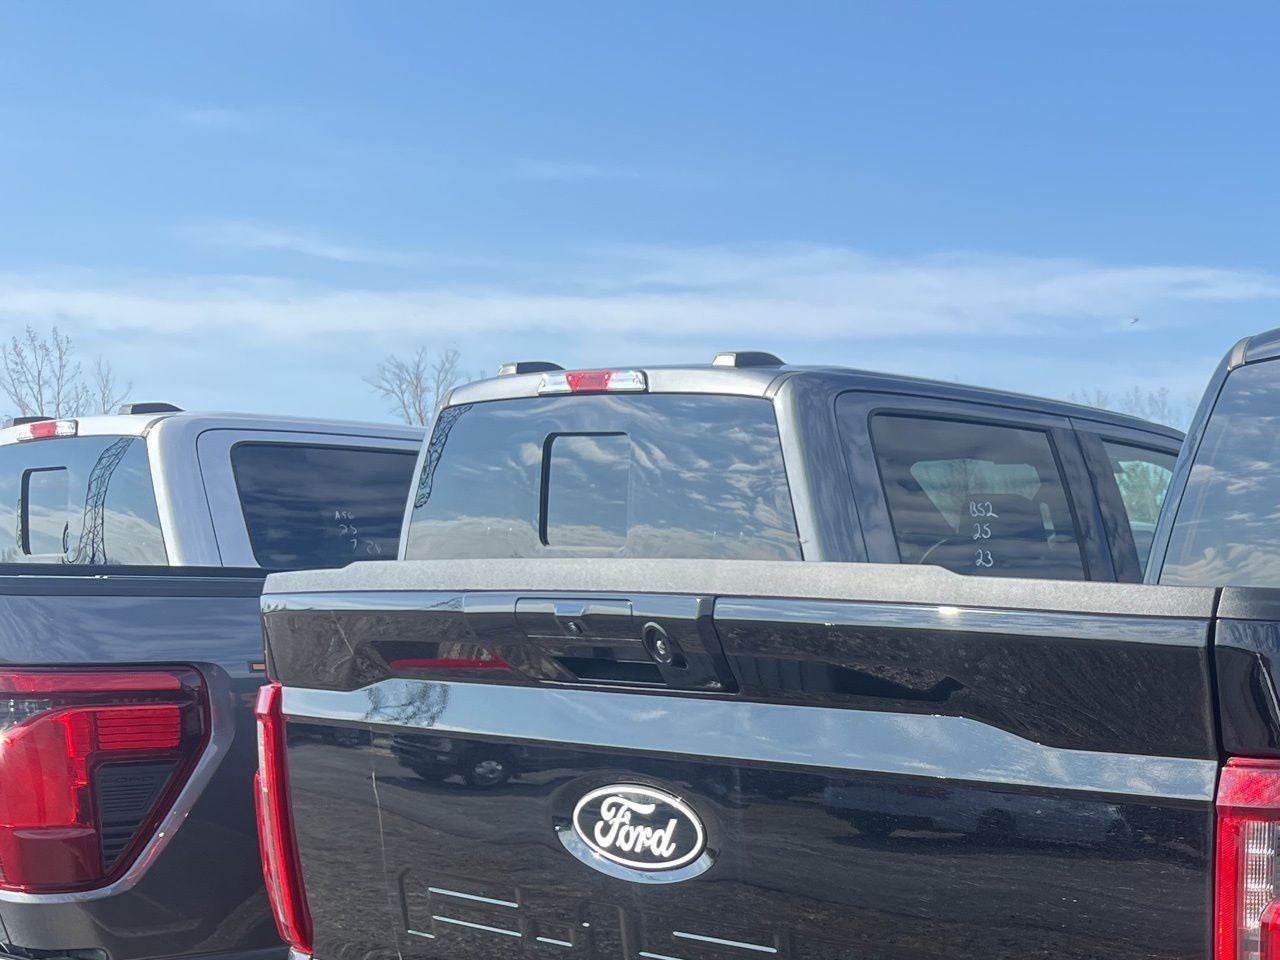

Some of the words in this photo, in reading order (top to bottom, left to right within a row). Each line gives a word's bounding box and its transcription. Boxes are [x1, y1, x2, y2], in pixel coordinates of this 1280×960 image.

[972, 522, 992, 540] 25
[975, 549, 994, 568] 23
[594, 796, 677, 858] Ford
